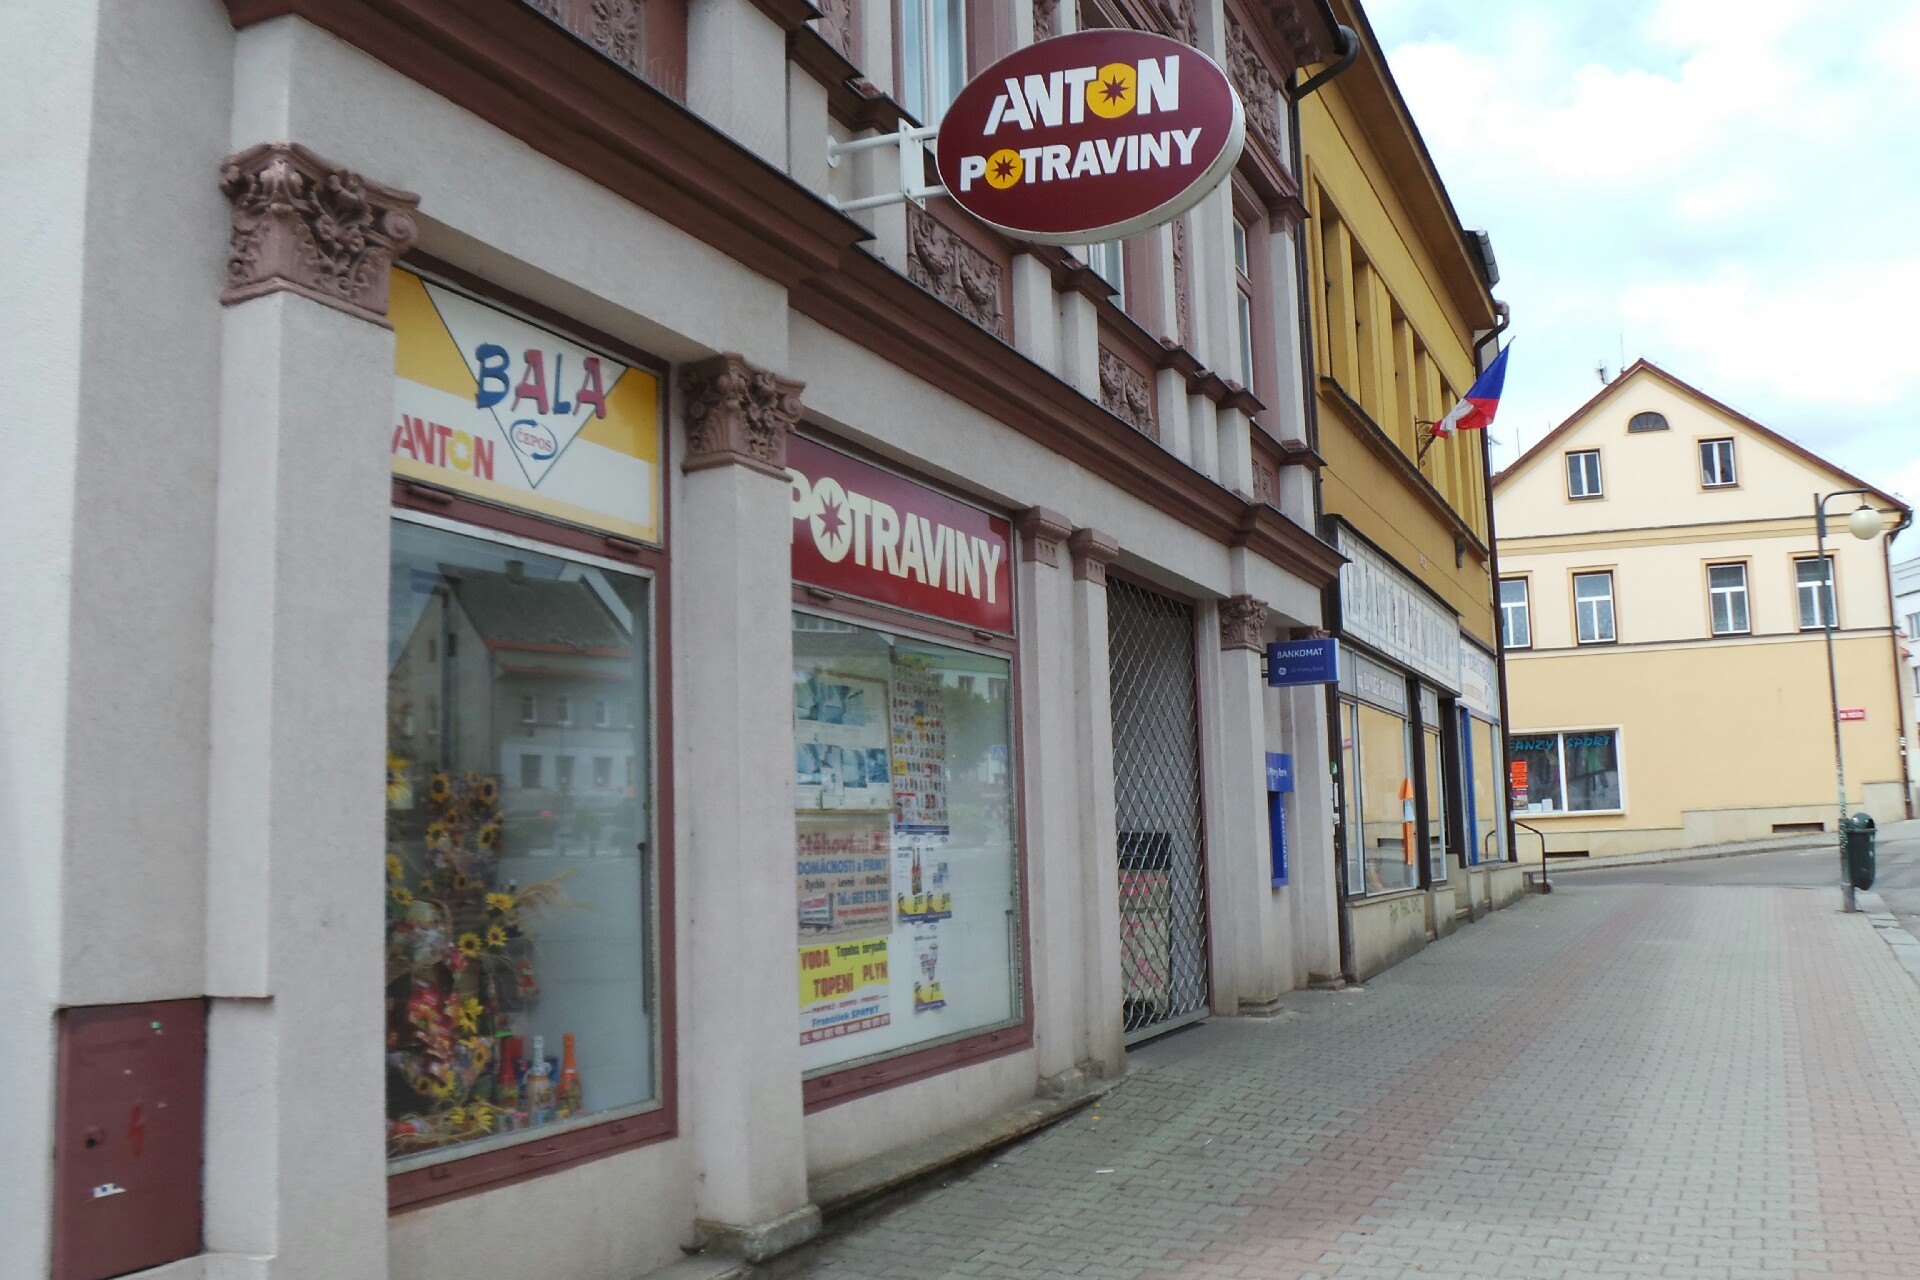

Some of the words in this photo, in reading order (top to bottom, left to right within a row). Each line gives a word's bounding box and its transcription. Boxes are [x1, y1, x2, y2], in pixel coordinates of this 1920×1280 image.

[983, 55, 1180, 136] ANTON
[960, 127, 1202, 192] POTRAVINY
[475, 342, 607, 420] BALA
[391, 413, 494, 481] ANTON
[785, 466, 1001, 604] POTRAVINY
[1277, 647, 1324, 659] BANKOMAT
[1566, 735, 1611, 749] SPORT
[800, 949, 831, 970] VODA
[813, 966, 855, 998] TOPENÍ
[863, 960, 888, 982] PLYN
